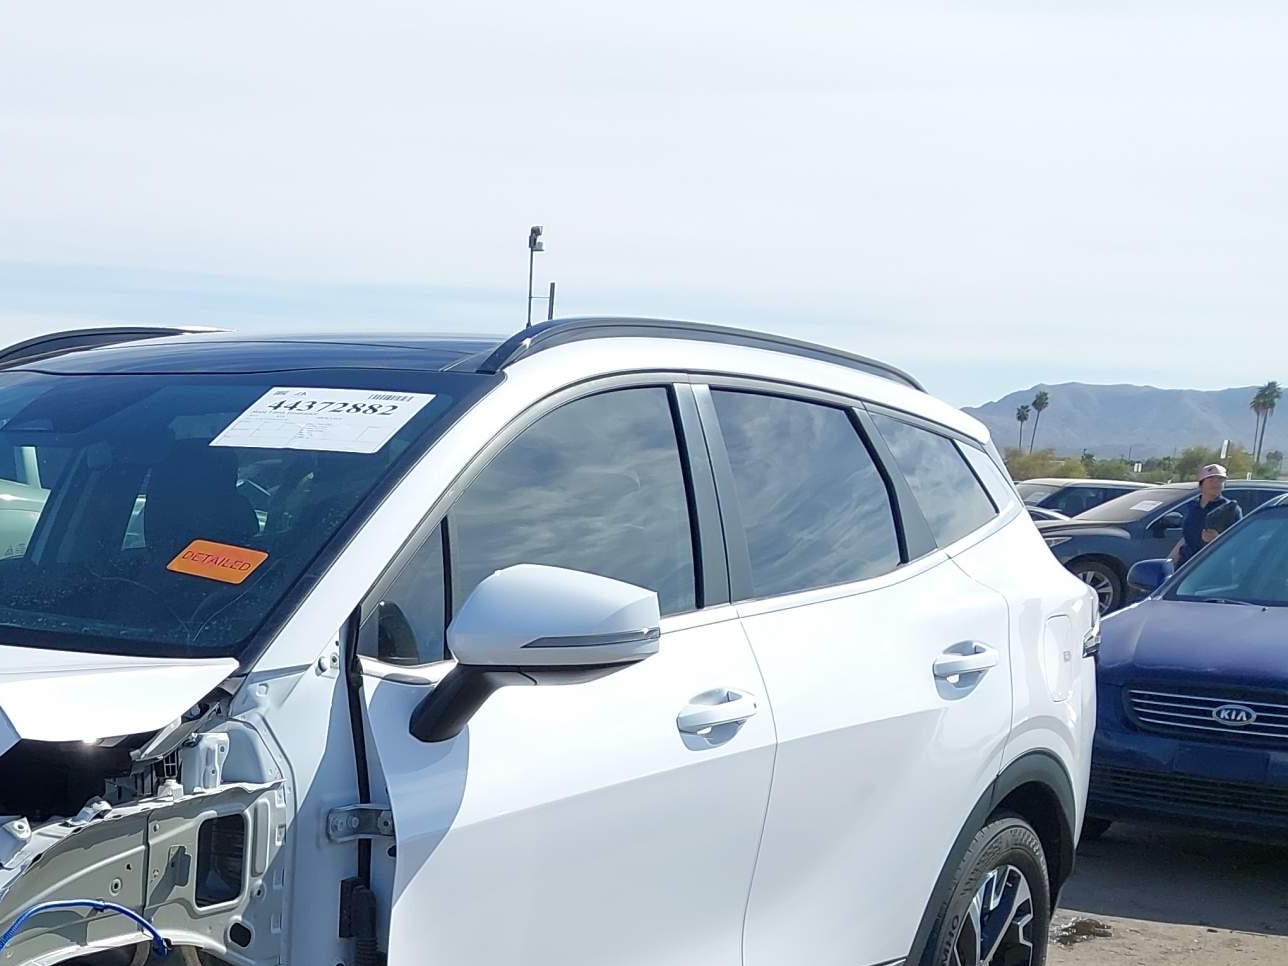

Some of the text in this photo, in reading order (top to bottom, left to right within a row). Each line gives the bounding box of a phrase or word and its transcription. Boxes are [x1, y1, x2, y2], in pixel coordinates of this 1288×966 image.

[267, 399, 399, 416] 44372882
[181, 550, 252, 572] DETAILED
[1220, 709, 1247, 721] KIA
